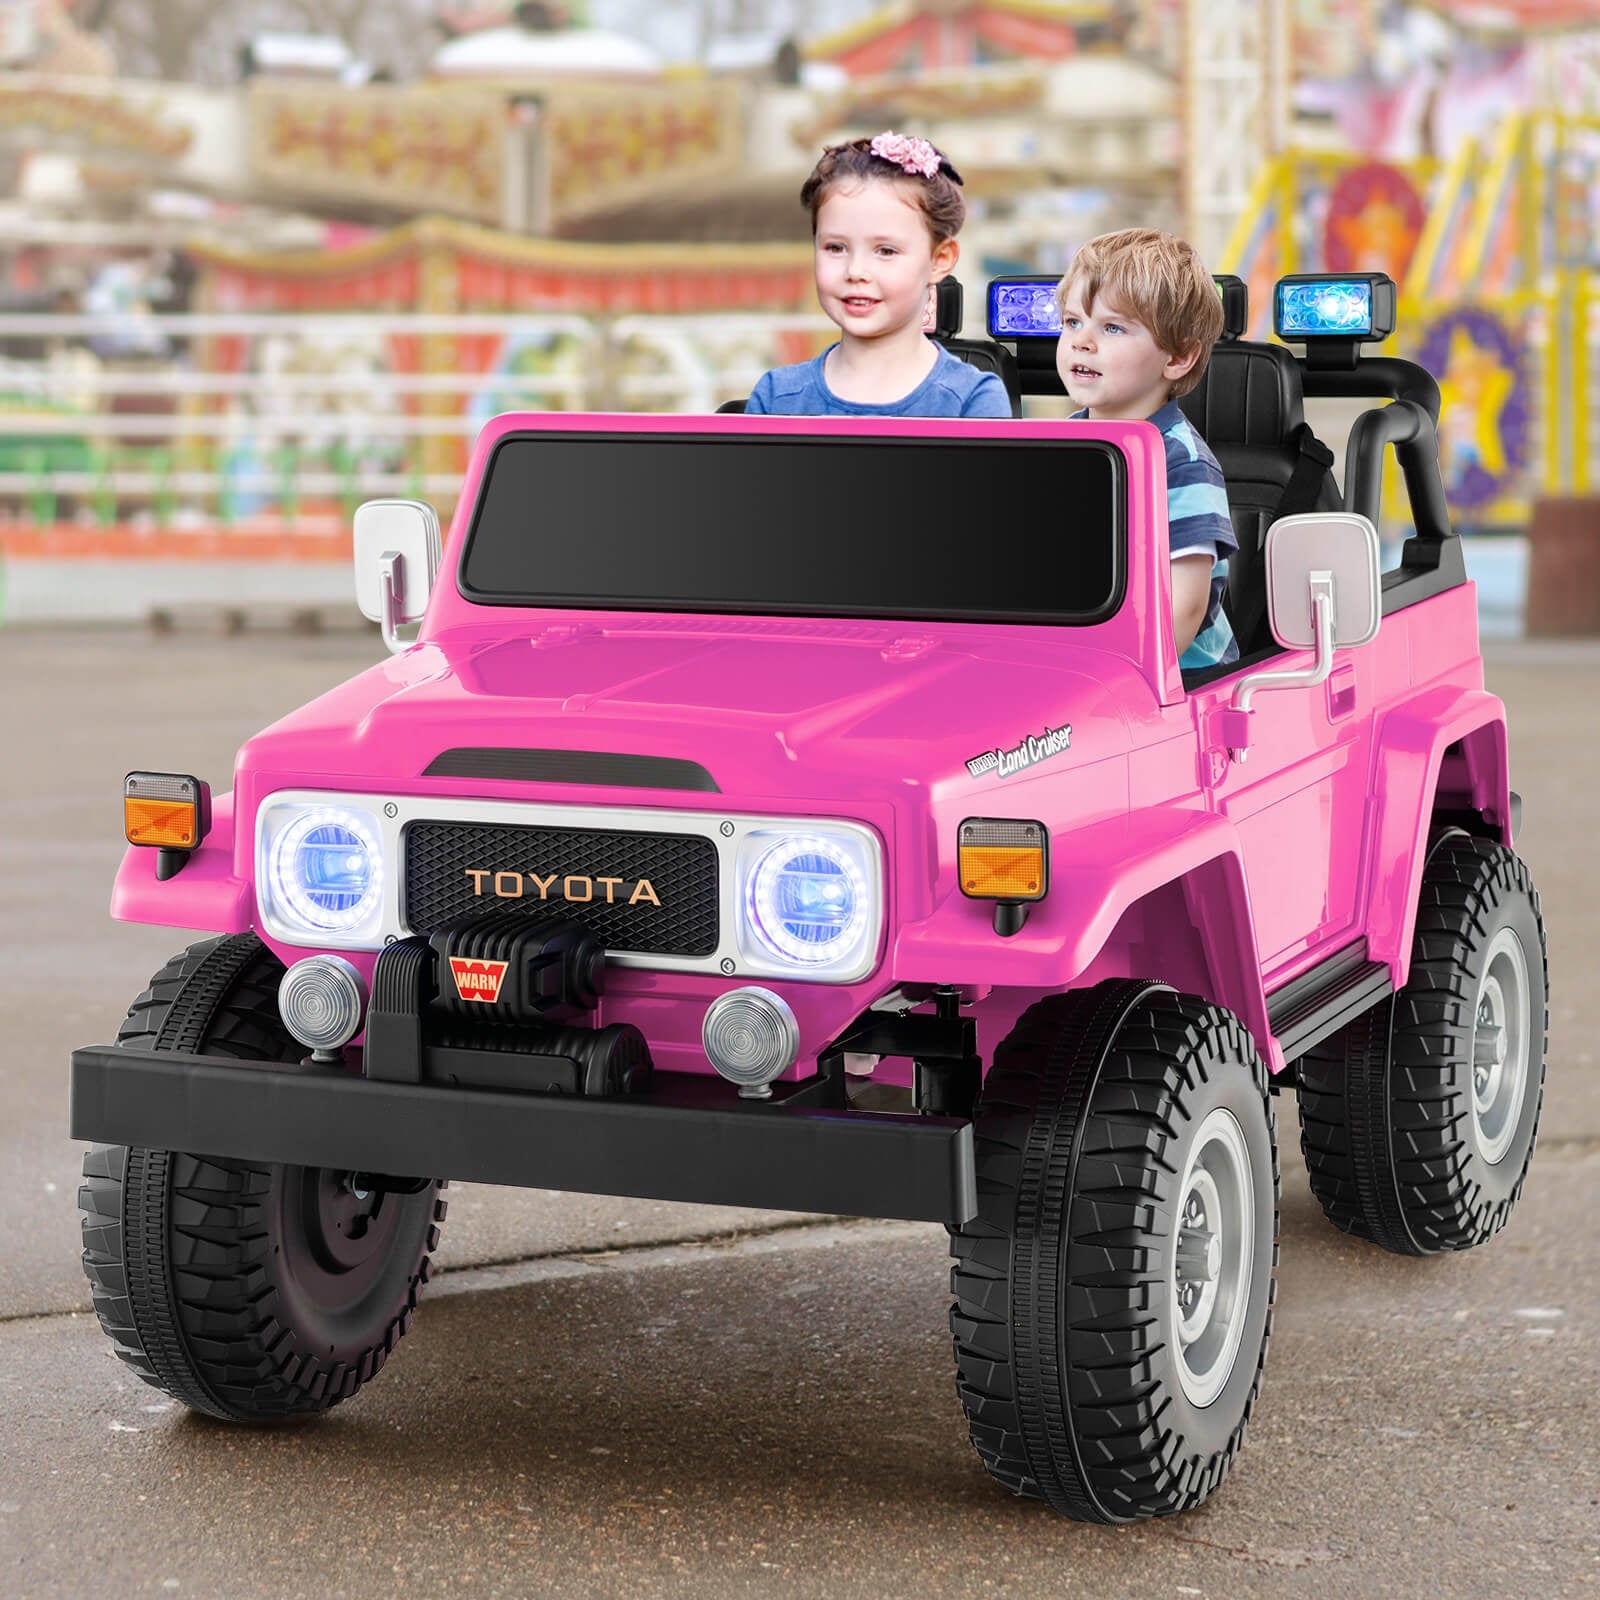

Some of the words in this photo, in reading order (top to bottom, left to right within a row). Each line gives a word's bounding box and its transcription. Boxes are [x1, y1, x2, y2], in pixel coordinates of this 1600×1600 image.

[998, 740, 1029, 776] Land
[1028, 726, 1071, 762] Cruiser
[465, 869, 661, 906] TOYOTA
[457, 971, 497, 991] WARN
